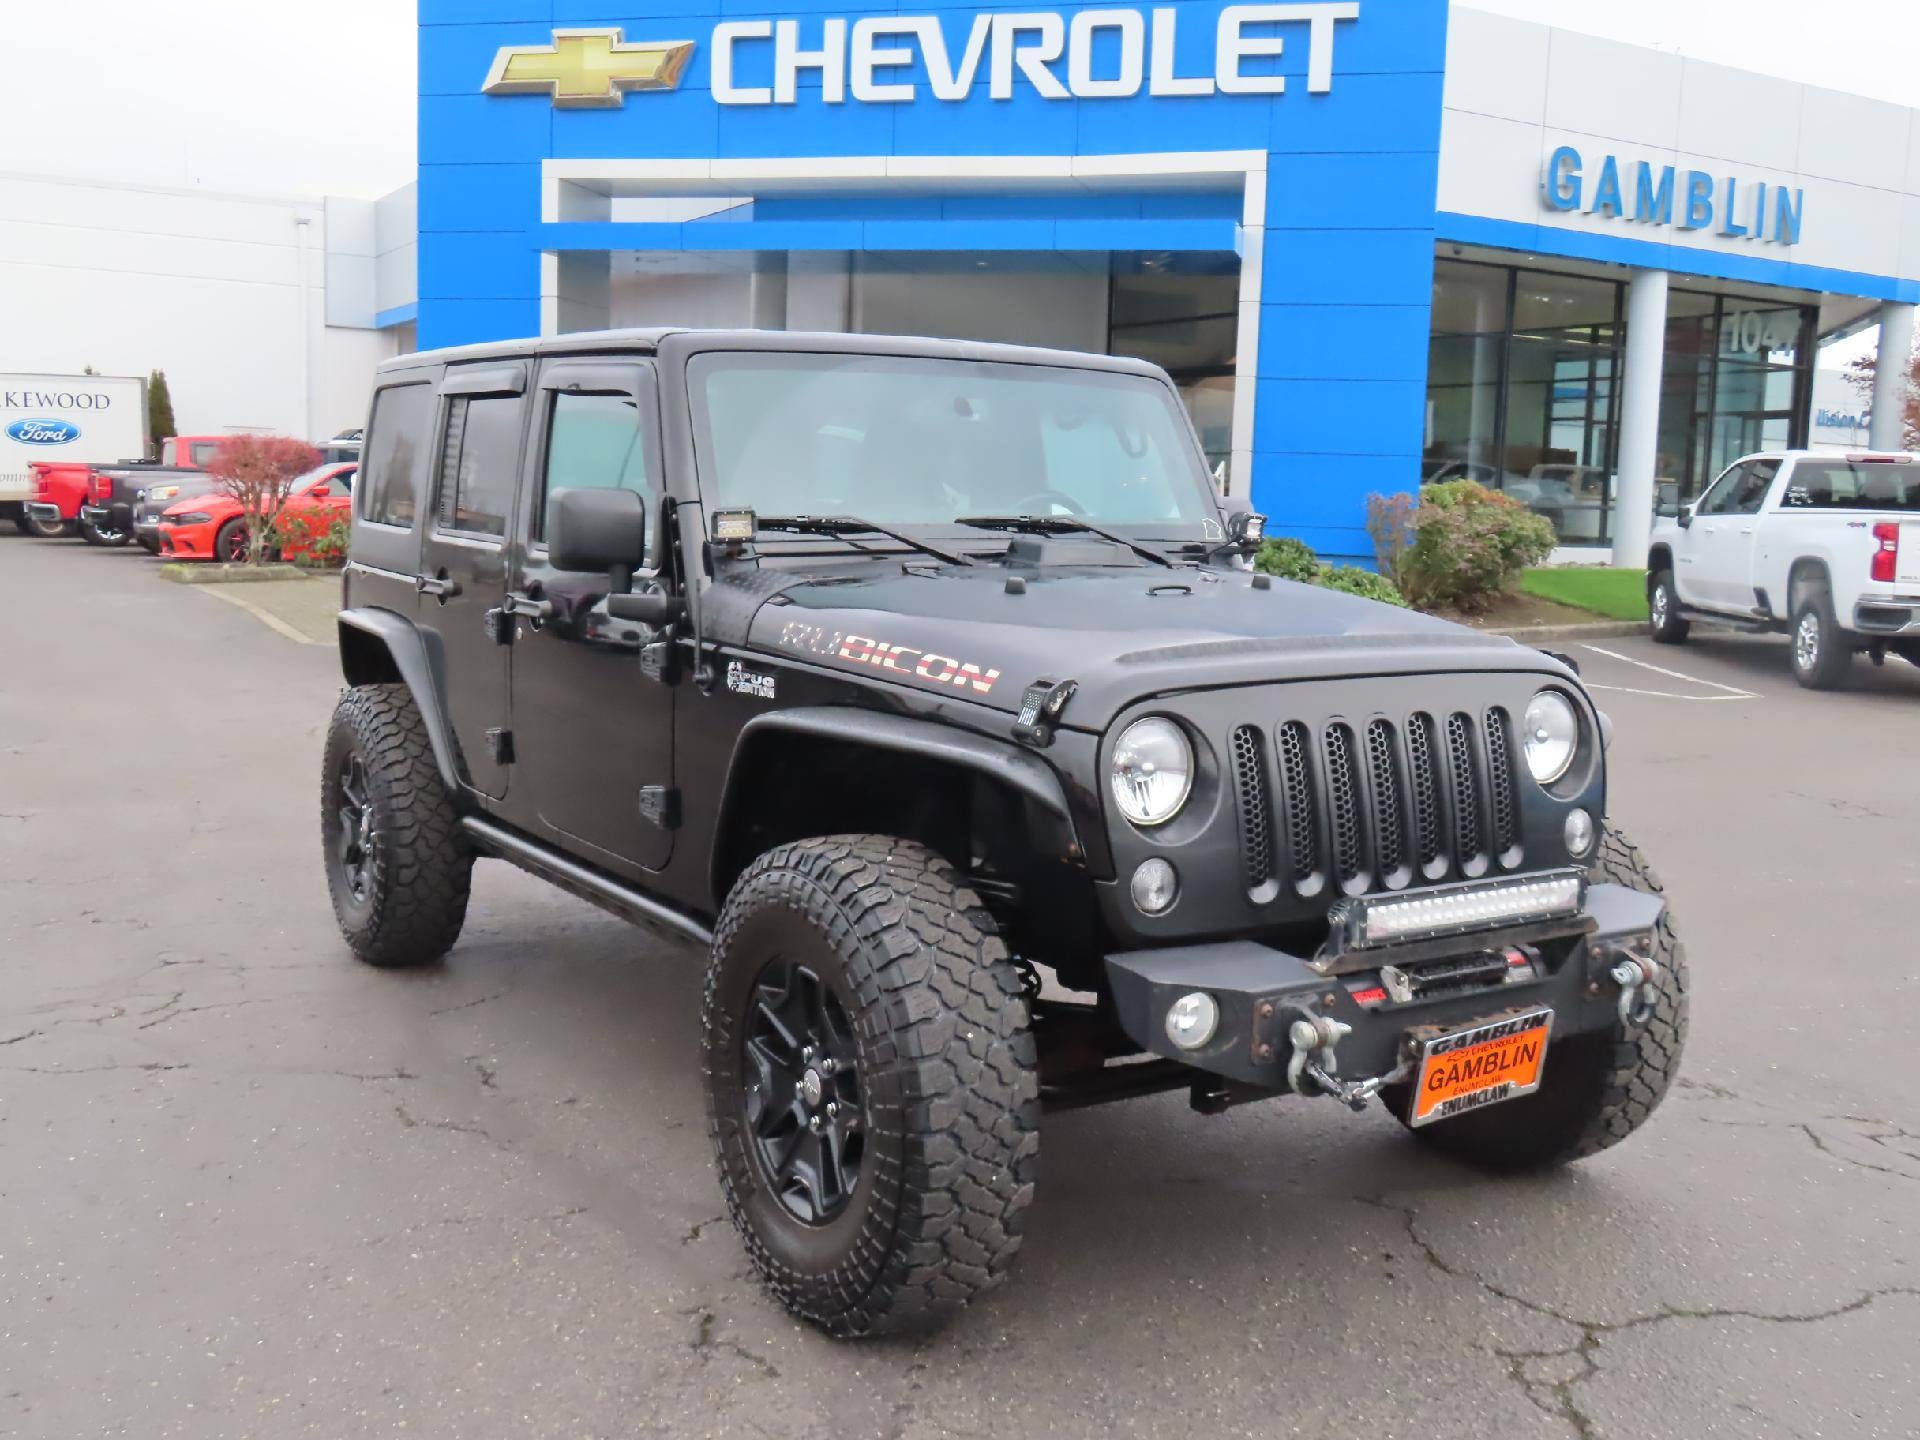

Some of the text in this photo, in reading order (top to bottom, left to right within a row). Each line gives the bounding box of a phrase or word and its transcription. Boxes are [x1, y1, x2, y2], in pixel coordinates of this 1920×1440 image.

[711, 2, 1360, 105] CHEVROLET
[1541, 145, 1803, 246] GAMBLIN
[0, 391, 111, 409] KEWOOD
[19, 421, 68, 441] Ford
[779, 620, 1000, 693] RUBICON
[1431, 1013, 1548, 1056] GAMBLIN
[1428, 1041, 1538, 1092] GAMBLIN
[1441, 1081, 1511, 1116] ENUMCLAW
